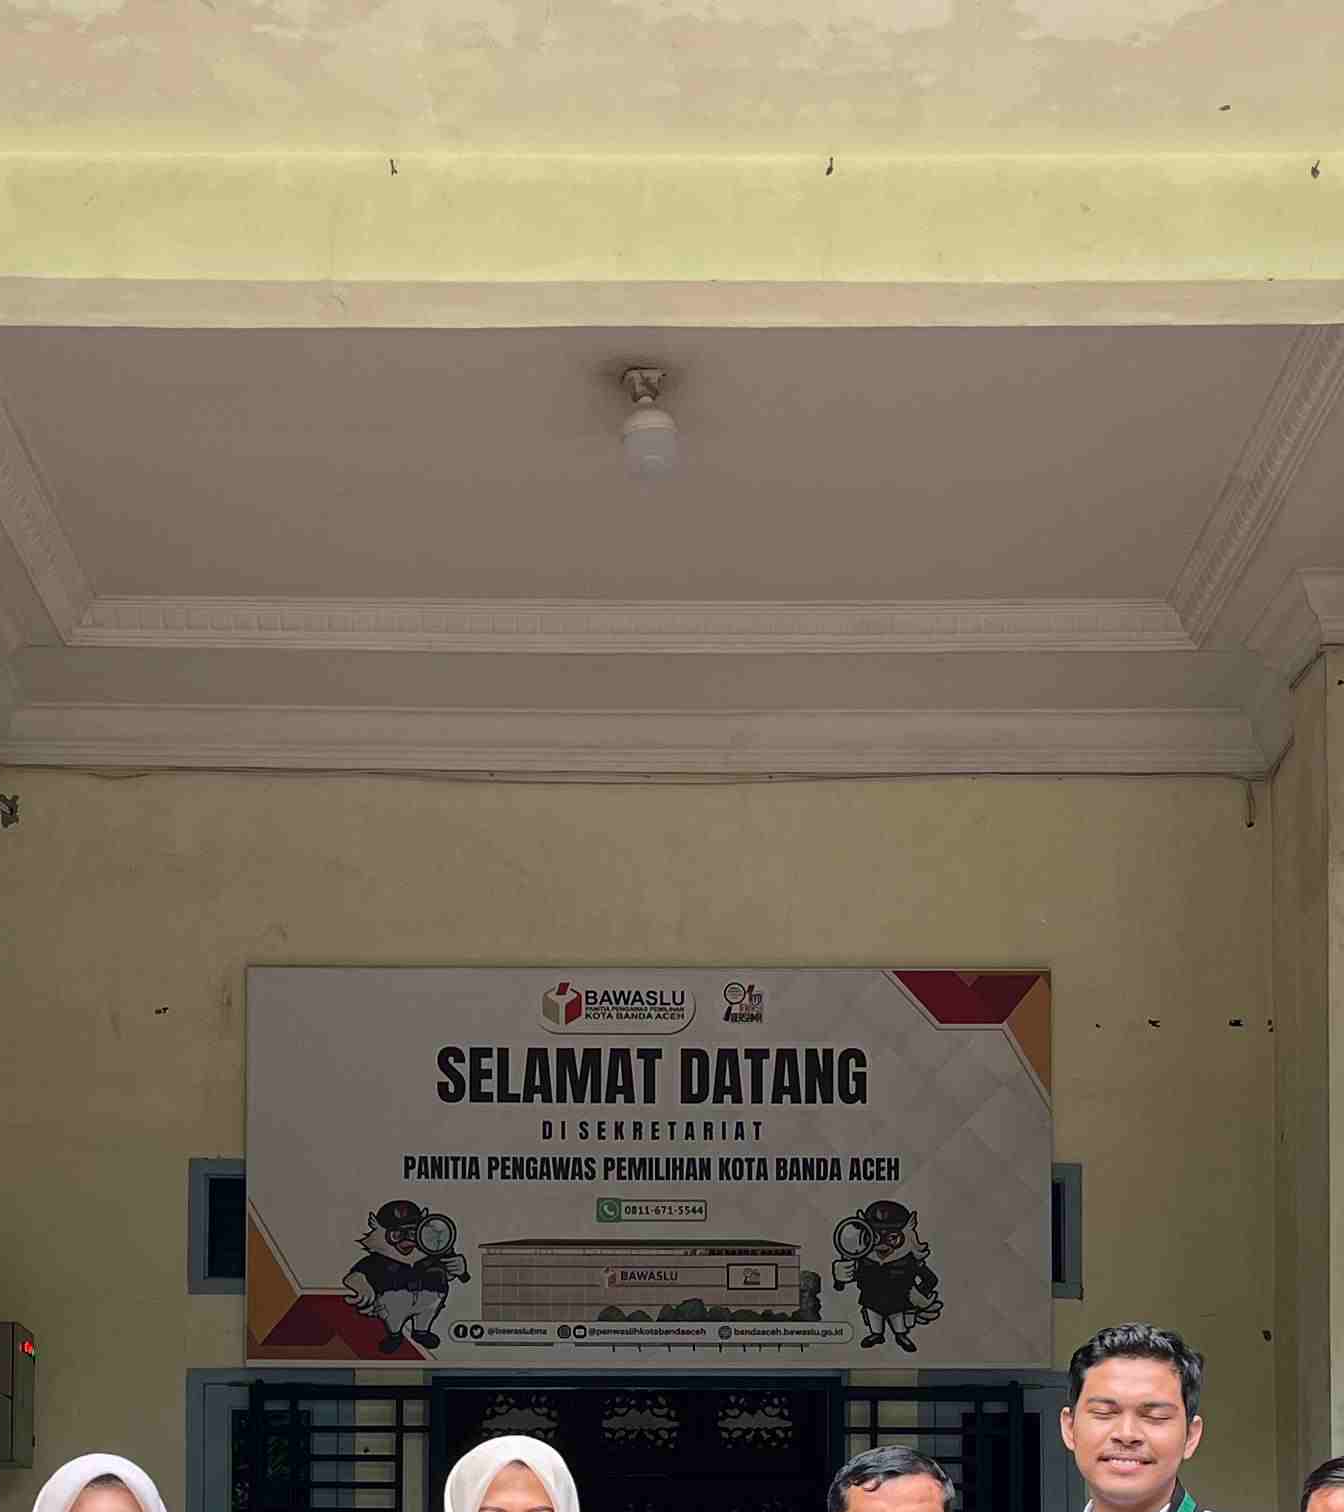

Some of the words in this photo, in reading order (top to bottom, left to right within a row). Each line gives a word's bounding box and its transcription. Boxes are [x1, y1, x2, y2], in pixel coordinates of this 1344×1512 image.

[585, 990, 685, 1006] BAWASLU
[585, 1012, 613, 1020] KOTA
[616, 1012, 653, 1020] BANDA
[655, 1012, 685, 1020] ACEH
[436, 1046, 663, 1104] SELAMAT
[680, 1046, 868, 1105] DATANG
[541, 1120, 567, 1141] DI
[577, 1120, 765, 1141] SEKRETARIAT
[403, 1155, 481, 1180] PANITIA
[487, 1156, 596, 1181] PENGAWAS
[603, 1156, 712, 1181] PEMILIHAN
[718, 1156, 769, 1181] KOTA
[775, 1156, 842, 1181] BANDA
[848, 1156, 901, 1181] ACEH
[624, 1205, 704, 1216] 0811-671-5544
[620, 1271, 678, 1281] BAWASLU
